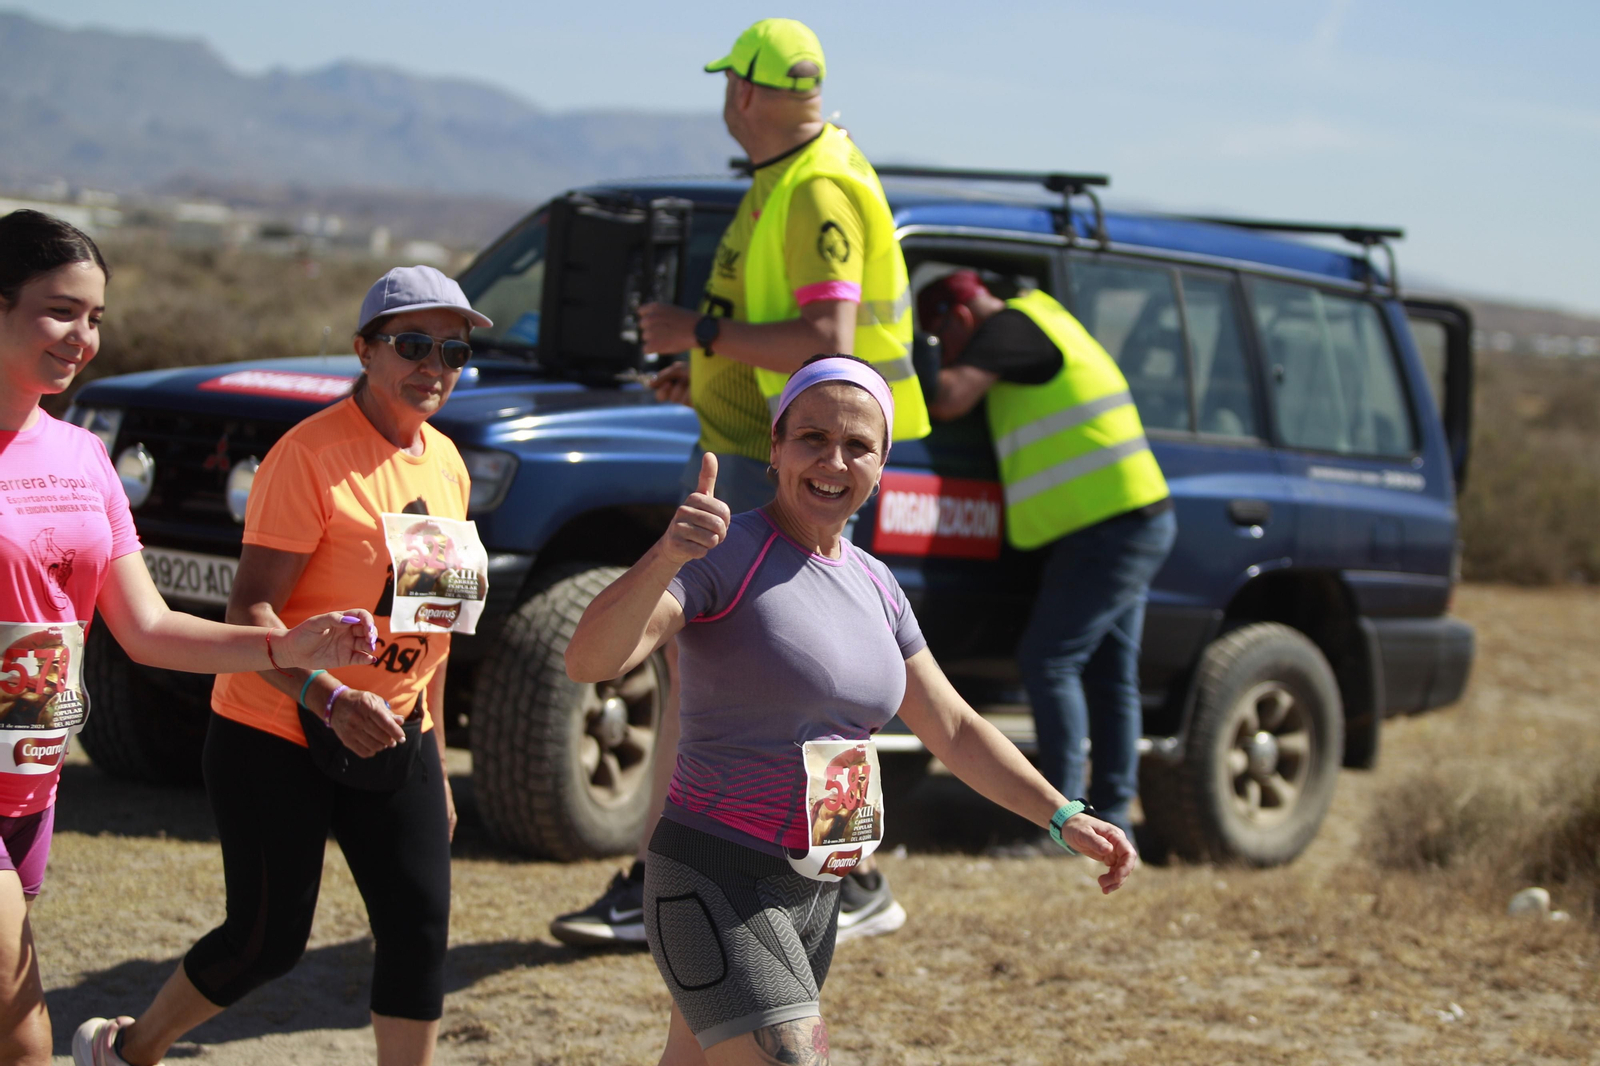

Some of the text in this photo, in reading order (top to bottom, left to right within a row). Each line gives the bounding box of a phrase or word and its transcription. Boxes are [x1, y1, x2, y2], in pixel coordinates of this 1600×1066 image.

[0, 477, 46, 491] arrera
[448, 568, 478, 580] XIII
[0, 647, 70, 695] 578
[22, 743, 64, 760] Caparr
[856, 805, 874, 819] XIII
